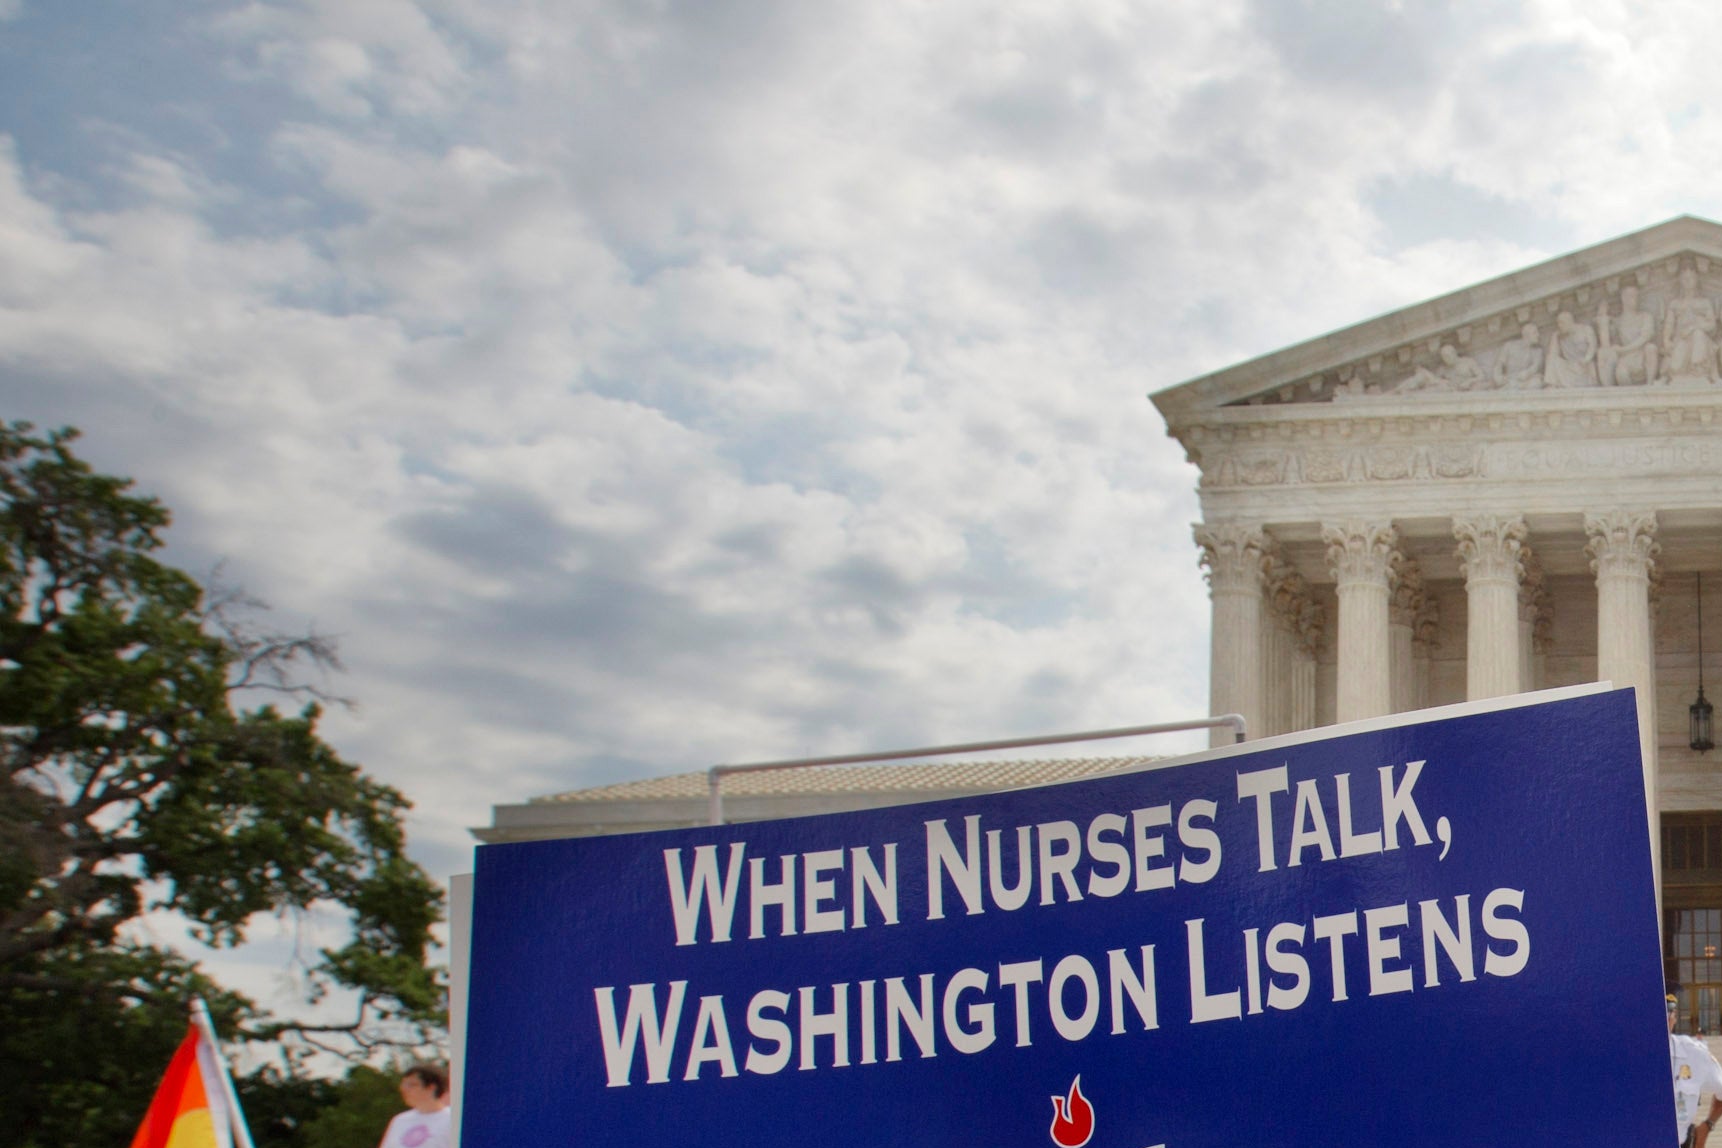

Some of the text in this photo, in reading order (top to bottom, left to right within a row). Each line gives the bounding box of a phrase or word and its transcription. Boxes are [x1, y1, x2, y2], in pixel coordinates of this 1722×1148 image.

[1606, 443, 1711, 469] JUSTICE
[663, 841, 900, 947] WHEN
[923, 798, 1222, 922] NURSES
[594, 887, 1531, 1088] WASHINGTON LISTENS
